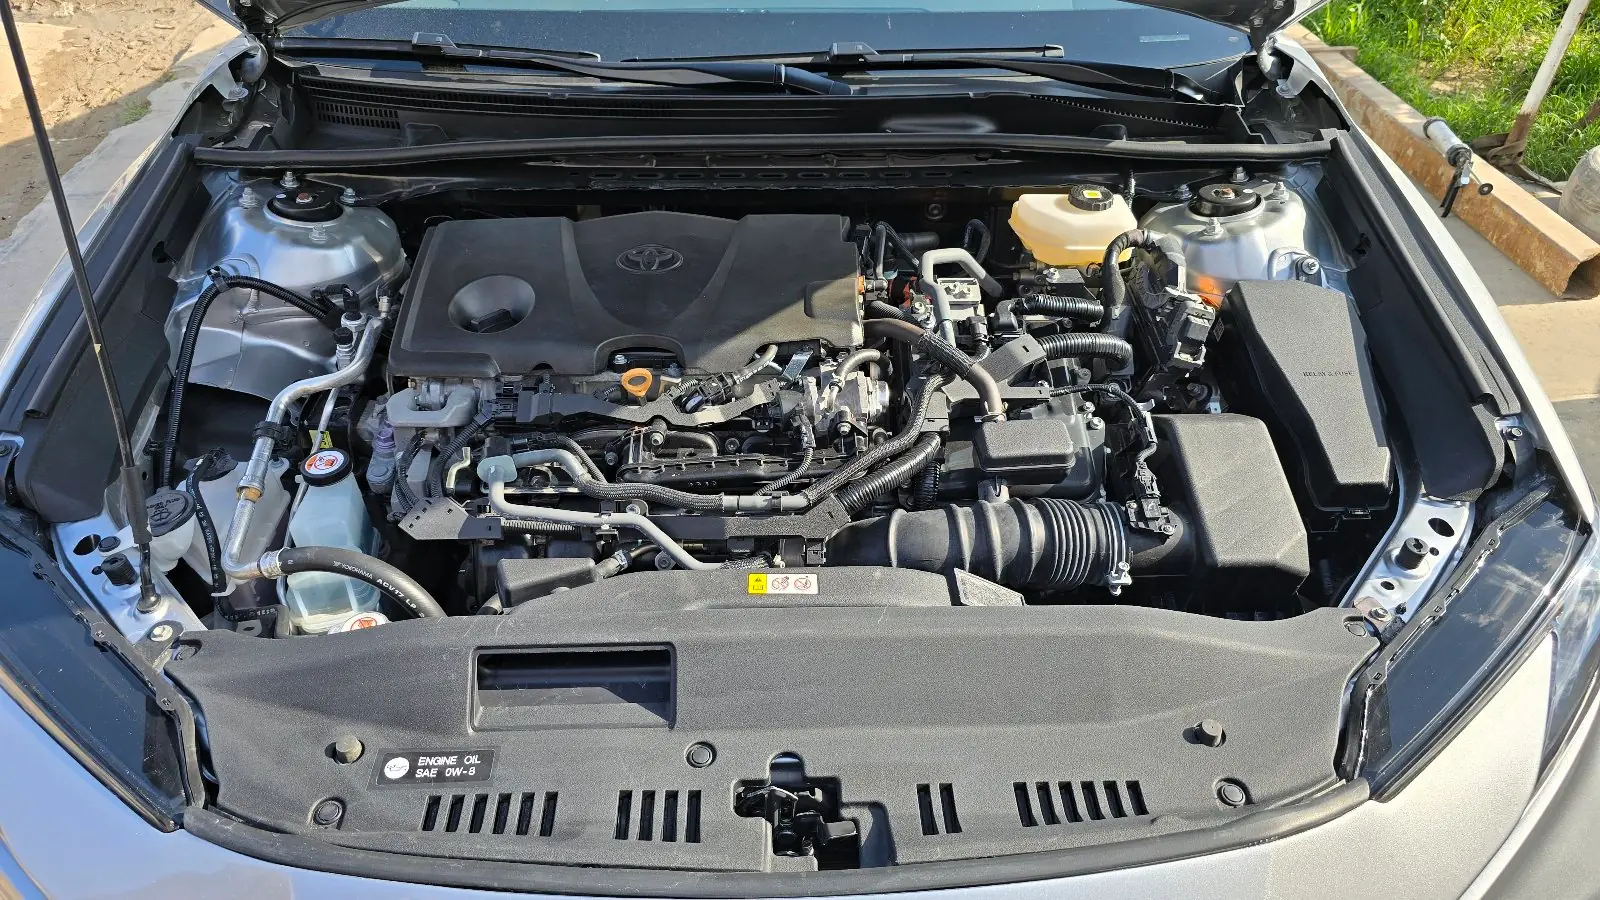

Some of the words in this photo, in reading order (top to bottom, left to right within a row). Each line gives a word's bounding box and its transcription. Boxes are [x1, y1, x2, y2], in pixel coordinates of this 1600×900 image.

[341, 563, 373, 580] YOKOHAMA
[376, 578, 405, 598] ACV17
[418, 756, 458, 767] ENGINE
[464, 755, 481, 765] OIL
[415, 768, 438, 778] SAE
